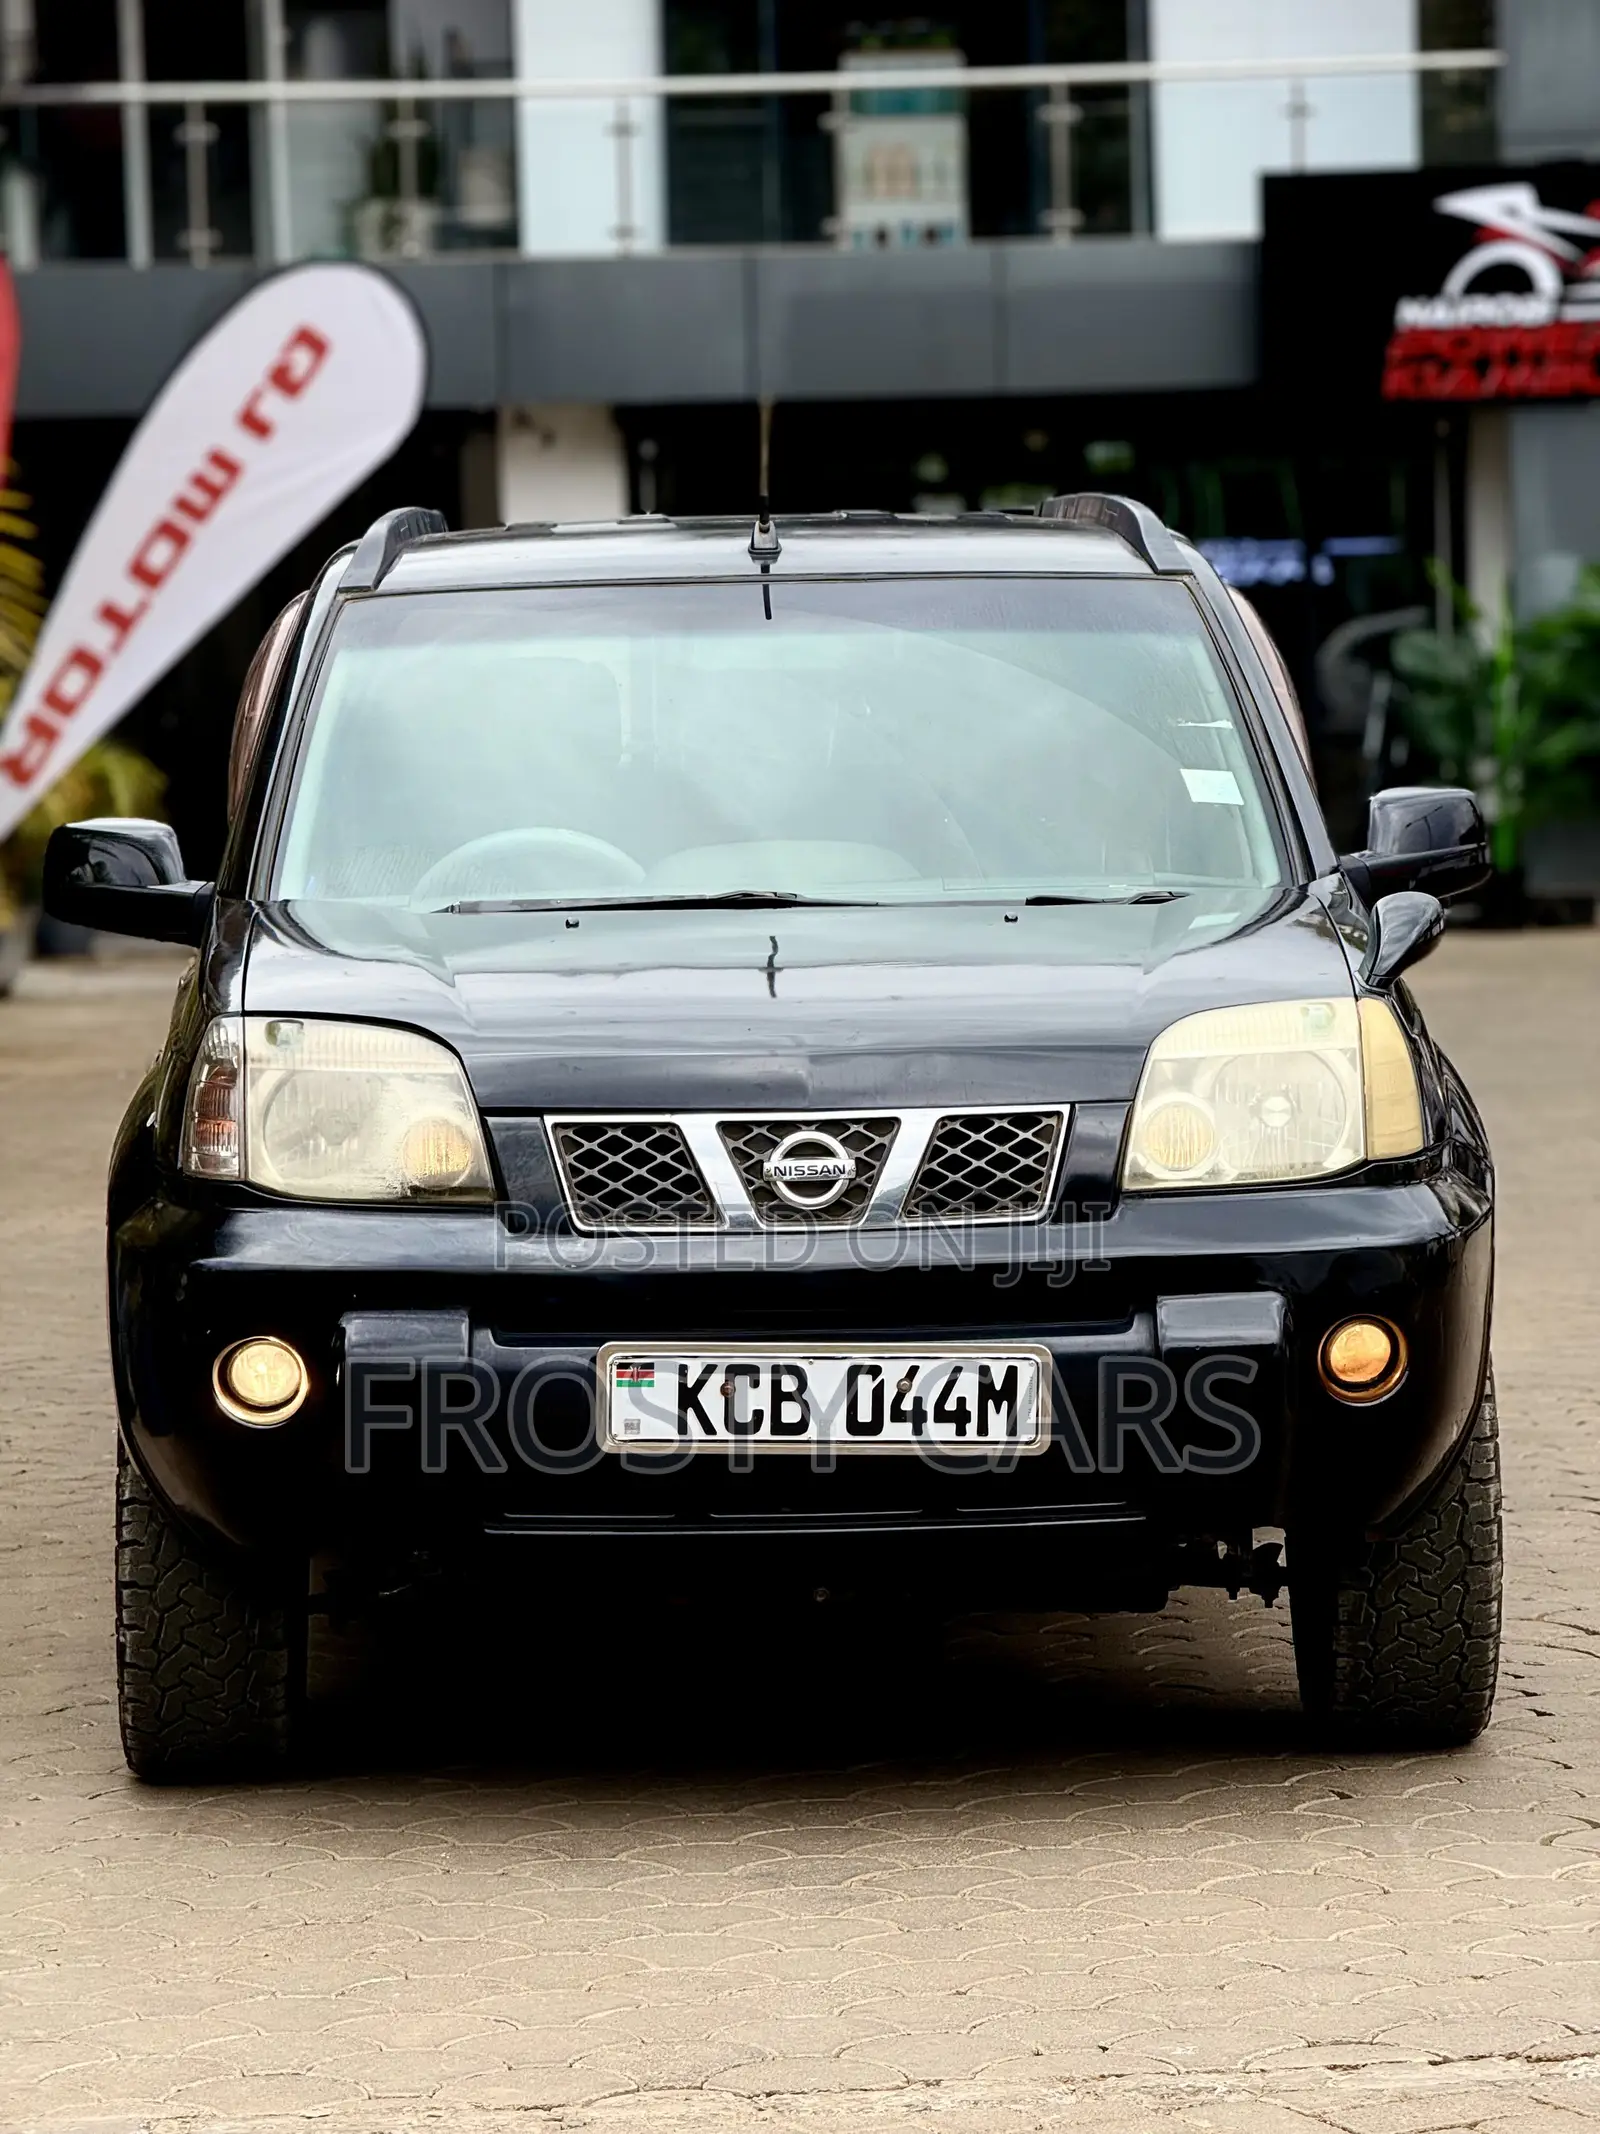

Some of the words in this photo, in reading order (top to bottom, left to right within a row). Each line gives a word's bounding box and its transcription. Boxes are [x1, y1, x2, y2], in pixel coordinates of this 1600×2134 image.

[0, 447, 243, 787] MOTOR
[773, 1164, 846, 1177] NISSAN
[677, 1363, 811, 1436] KCB
[845, 1364, 1019, 1437] 044M
